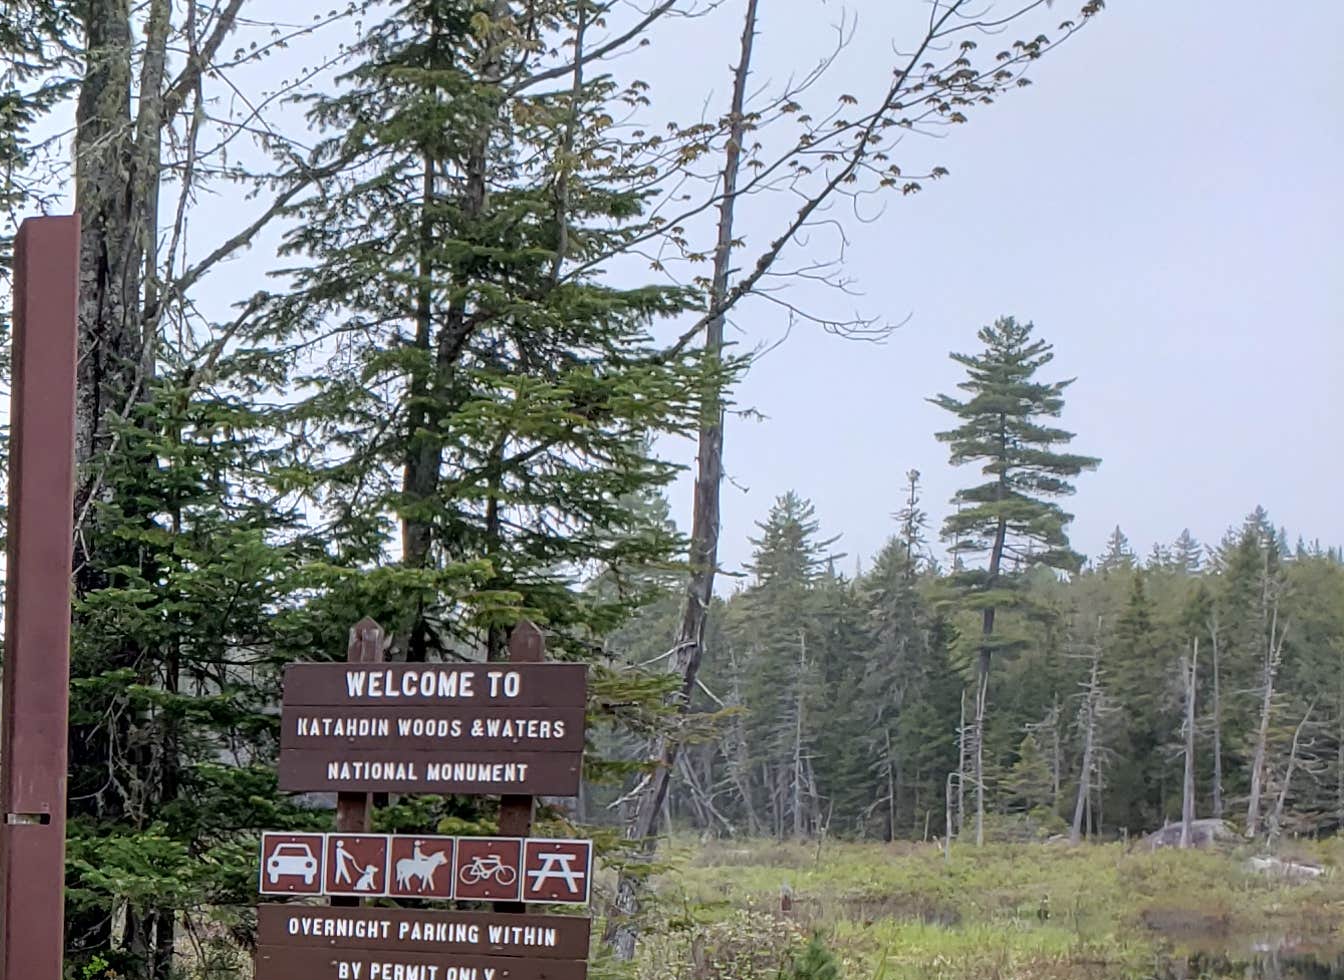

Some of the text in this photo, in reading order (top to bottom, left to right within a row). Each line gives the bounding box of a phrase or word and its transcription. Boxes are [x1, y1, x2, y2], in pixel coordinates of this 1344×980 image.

[346, 670, 520, 697] WELCOME TO
[297, 718, 388, 736] KATAHDIN
[397, 719, 461, 736] WOODS
[327, 762, 527, 781] NATIONAL MONUMENT
[289, 918, 555, 946] OVERNIGHT PARKING WITHIN
[338, 962, 361, 979] BY
